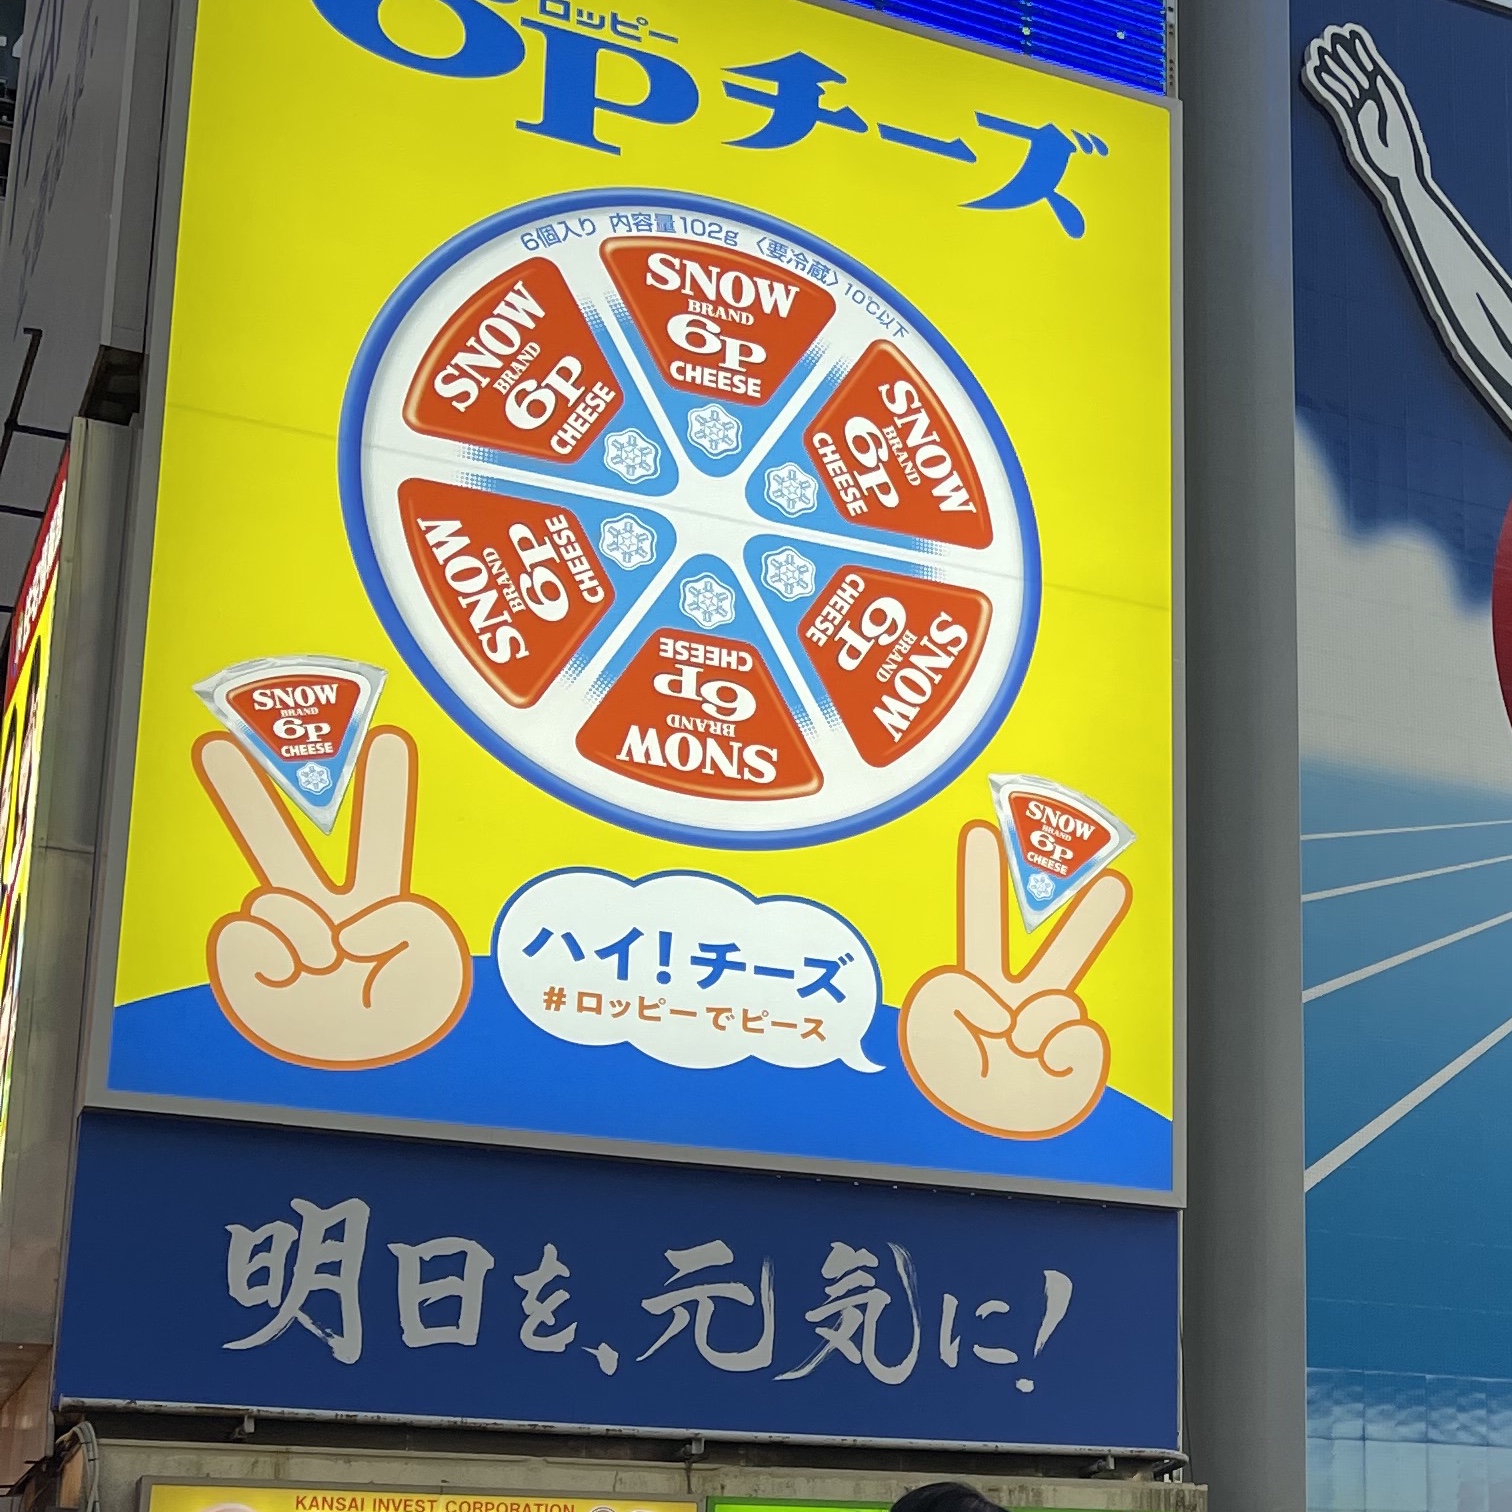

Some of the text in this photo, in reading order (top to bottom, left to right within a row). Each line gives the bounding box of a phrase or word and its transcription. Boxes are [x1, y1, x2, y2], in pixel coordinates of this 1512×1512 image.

[520, 217, 596, 251] 6個入り
[645, 252, 800, 318] SNOW
[687, 299, 754, 326] BRAND
[433, 280, 546, 412] SNOW
[492, 341, 541, 395] BRAND
[669, 360, 762, 398] CHEESE
[550, 381, 616, 455] CHEESE
[812, 432, 868, 517] CHEESE
[878, 379, 977, 515] SNOW
[882, 425, 921, 487] BRAND
[482, 547, 527, 613] BRAND
[545, 514, 606, 604] CHEESE
[416, 517, 530, 664] SNOW
[805, 573, 865, 647] CHEESE
[659, 636, 753, 672] CHEESE
[873, 611, 968, 743] SNOW
[876, 629, 918, 683] BRAND
[252, 683, 339, 711] SNOW
[280, 706, 319, 718] BRAND
[280, 742, 333, 757] CHEESE
[666, 713, 736, 738] BRAND
[616, 724, 778, 784] SNOW
[1025, 800, 1096, 841] SNOW
[1042, 824, 1072, 842] BRAND
[1026, 851, 1068, 875] CHEESE
[522, 926, 855, 1003] ハイ!チーズ
[542, 986, 826, 1042] #ロッピーでピース
[222, 1197, 1075, 1393] 明日を、元気に!
[295, 1495, 365, 1512] KANSAI
